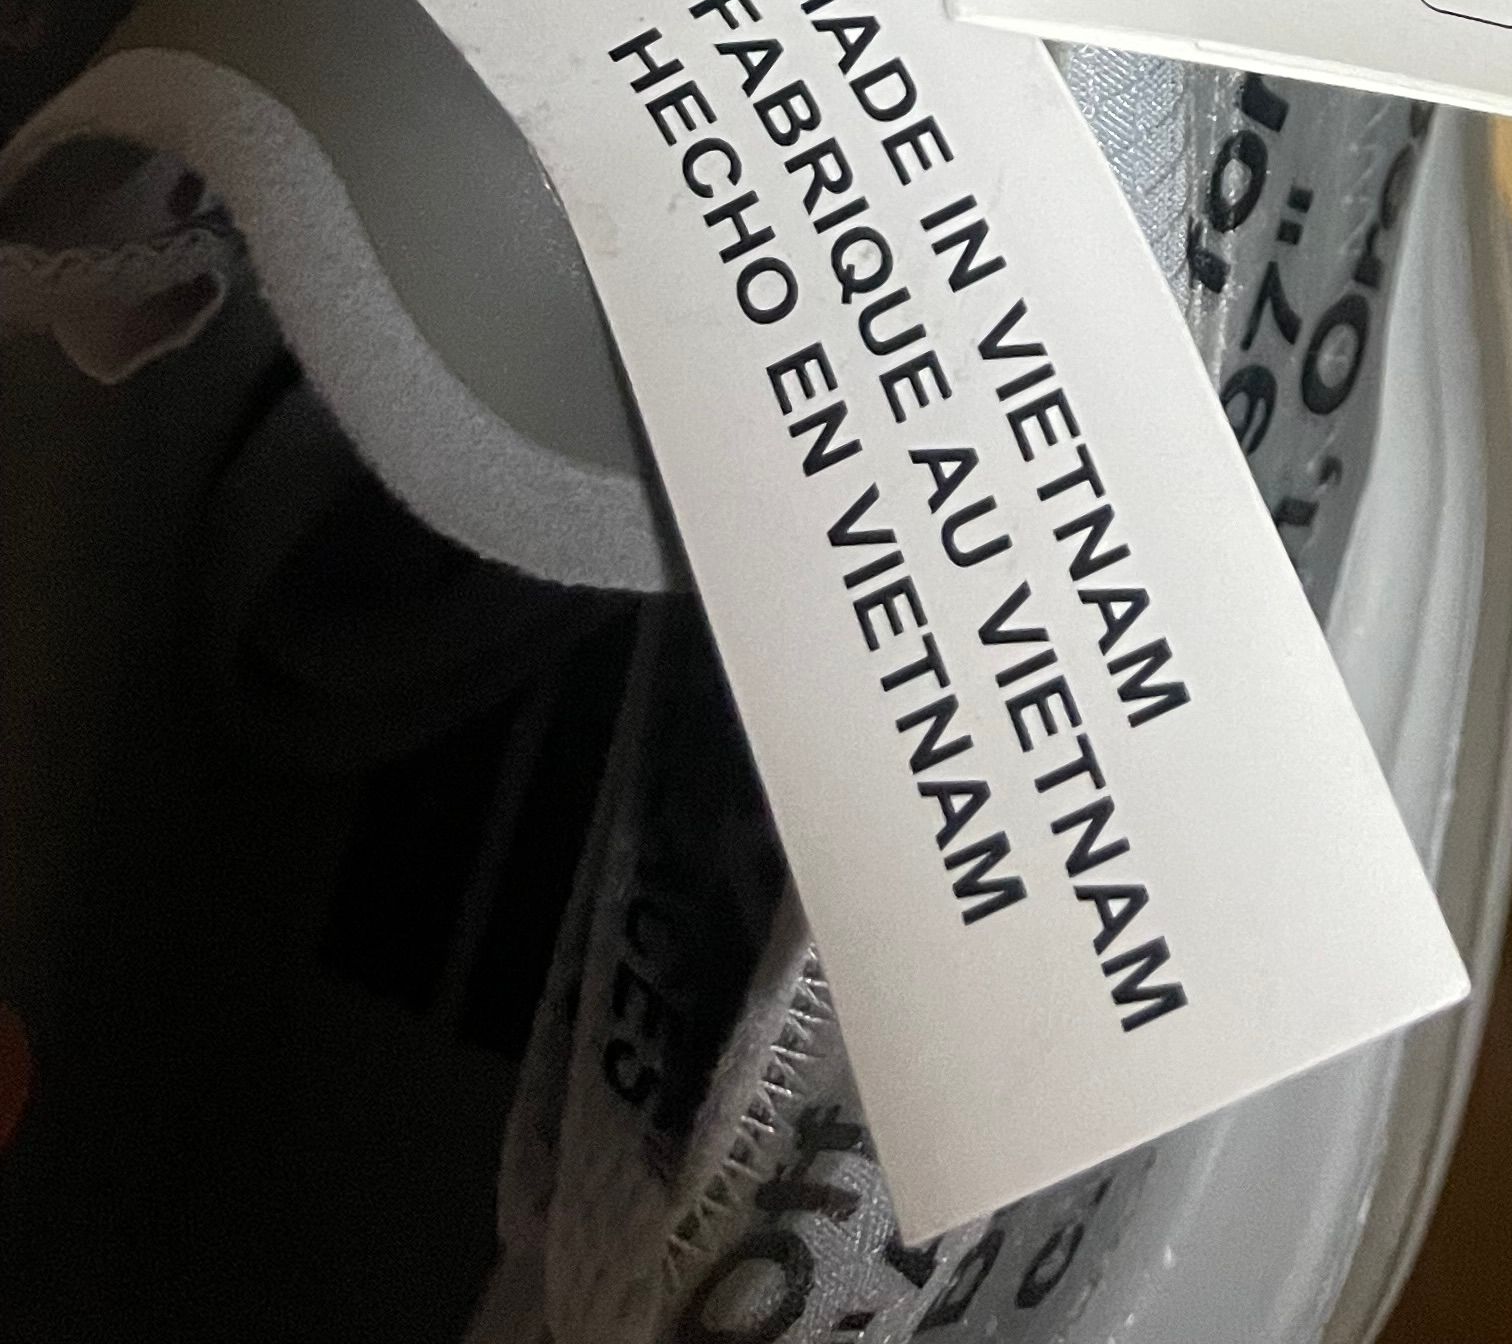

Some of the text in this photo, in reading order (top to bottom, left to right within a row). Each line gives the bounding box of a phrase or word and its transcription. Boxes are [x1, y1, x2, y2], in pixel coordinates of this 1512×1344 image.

[607, 28, 1028, 925] HECHO EN VIETNAM
[909, 447, 1013, 569] AU
[977, 582, 1189, 1032] VIETNAM
[921, 194, 1007, 292] IN
[977, 298, 1192, 727] VIETNAM
